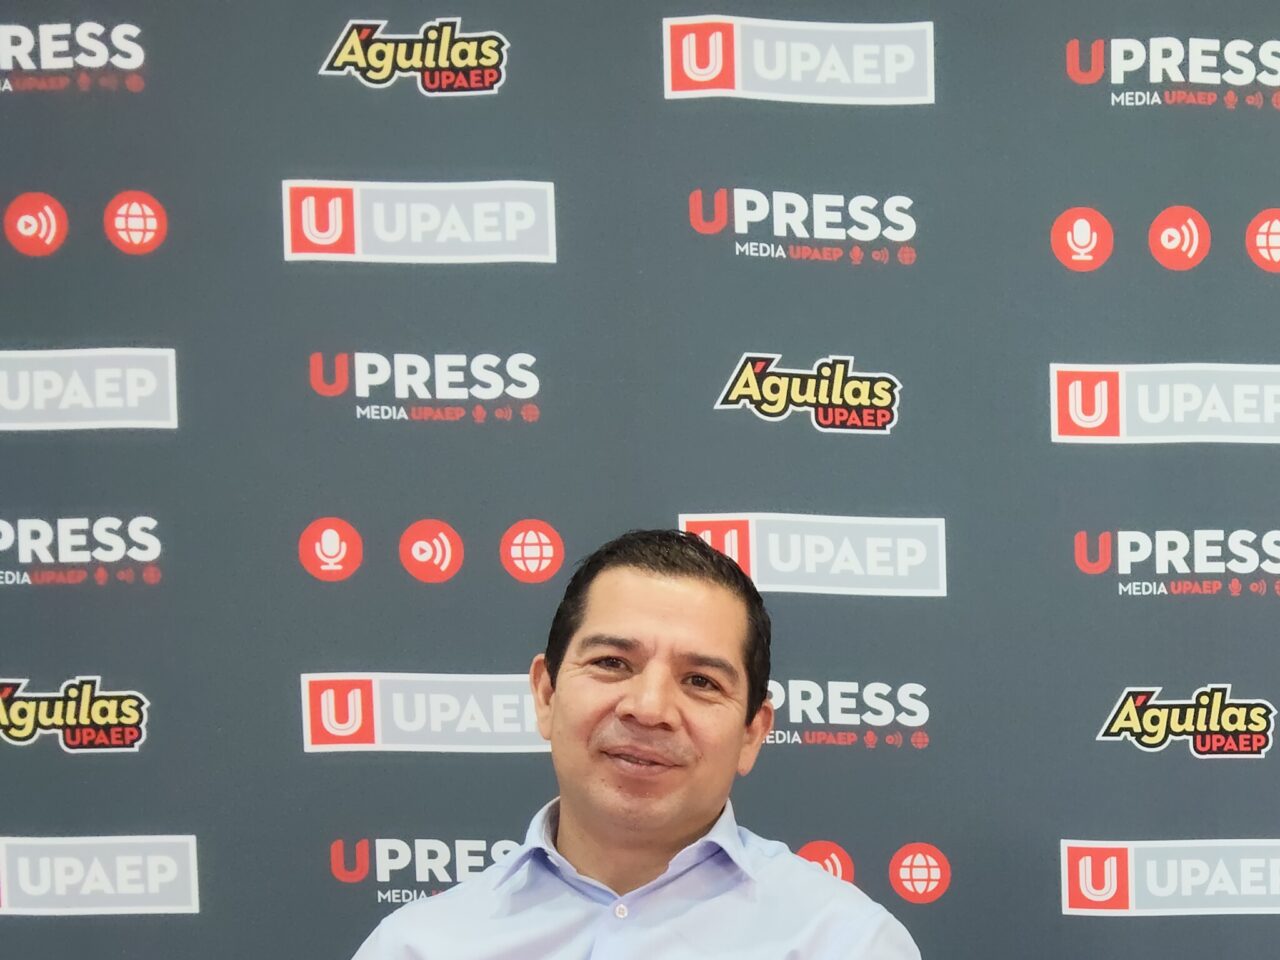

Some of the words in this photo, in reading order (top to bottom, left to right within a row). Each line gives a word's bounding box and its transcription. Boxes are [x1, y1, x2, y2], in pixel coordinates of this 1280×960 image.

[336, 26, 498, 79] Águilas
[682, 32, 723, 82] U
[754, 40, 915, 84] UPAEP
[424, 69, 498, 89] UPAEP
[1111, 91, 1161, 106] MEDIA
[302, 196, 343, 245] U
[374, 202, 535, 242] UPAEP
[689, 188, 916, 241] UPRESS
[736, 242, 786, 258] MEDIA
[0, 368, 158, 410] UPAEP
[310, 352, 539, 400] UPRESS
[730, 362, 891, 413] Águilas
[356, 405, 408, 420] MEDIA
[818, 407, 891, 427] UPAEP
[1069, 380, 1108, 428] U
[769, 533, 926, 576] UPAEP
[1119, 582, 1168, 595] MEDIA
[321, 689, 362, 736] U
[1111, 692, 1266, 744] Águilas
[66, 727, 138, 745] UPAEP
[761, 731, 802, 744] EDIA
[1196, 734, 1265, 752] UPAEP
[18, 855, 177, 895] UPAEP
[1079, 856, 1117, 901] U
